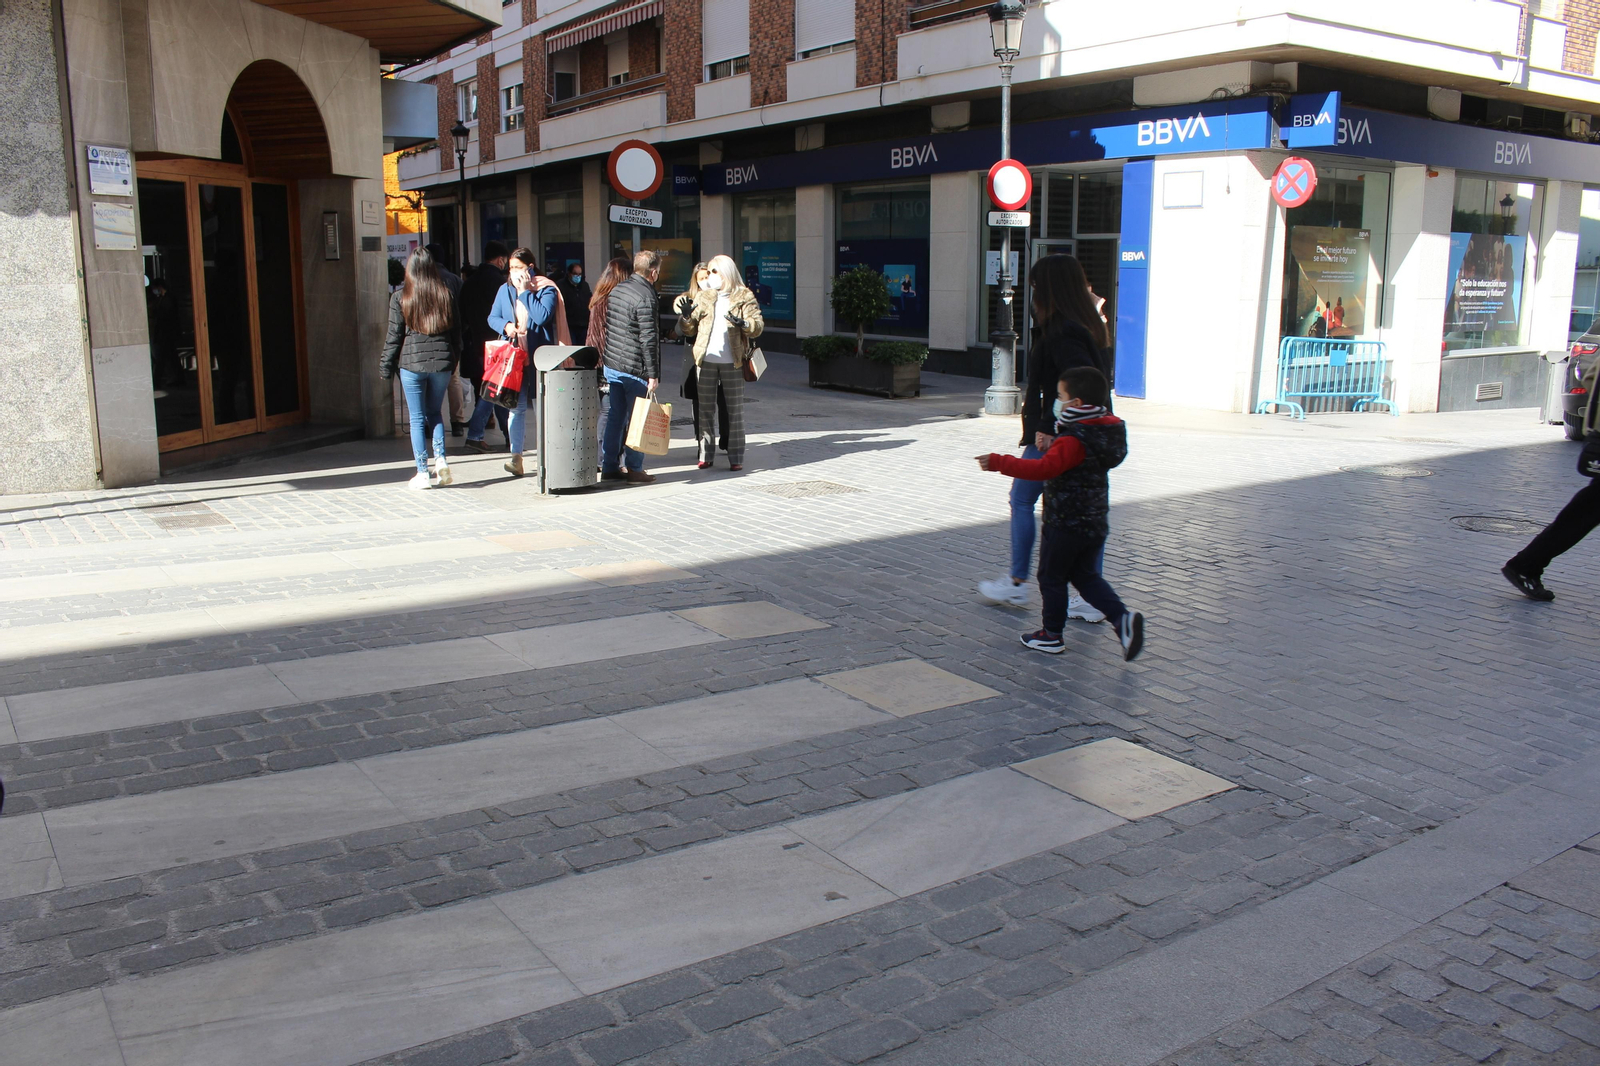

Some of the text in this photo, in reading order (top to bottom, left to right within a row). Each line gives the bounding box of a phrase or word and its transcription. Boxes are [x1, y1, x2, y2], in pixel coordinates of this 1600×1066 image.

[1293, 111, 1332, 128] BBVA
[1137, 111, 1210, 146] BBVA
[1338, 118, 1373, 145] BVA
[891, 141, 938, 169] BBVA
[1494, 141, 1532, 165] BBVA
[675, 176, 698, 184] BBVA
[726, 164, 758, 186] BBVA
[625, 208, 648, 217] EXCEPTO
[619, 215, 653, 225] AUTORIZADOS
[1328, 246, 1342, 255] mejor
[1342, 246, 1357, 254] futuro
[1122, 251, 1146, 261] BBVA
[1339, 255, 1348, 264] hoy
[1477, 279, 1498, 287] educación
[1465, 290, 1486, 298] esperanza
